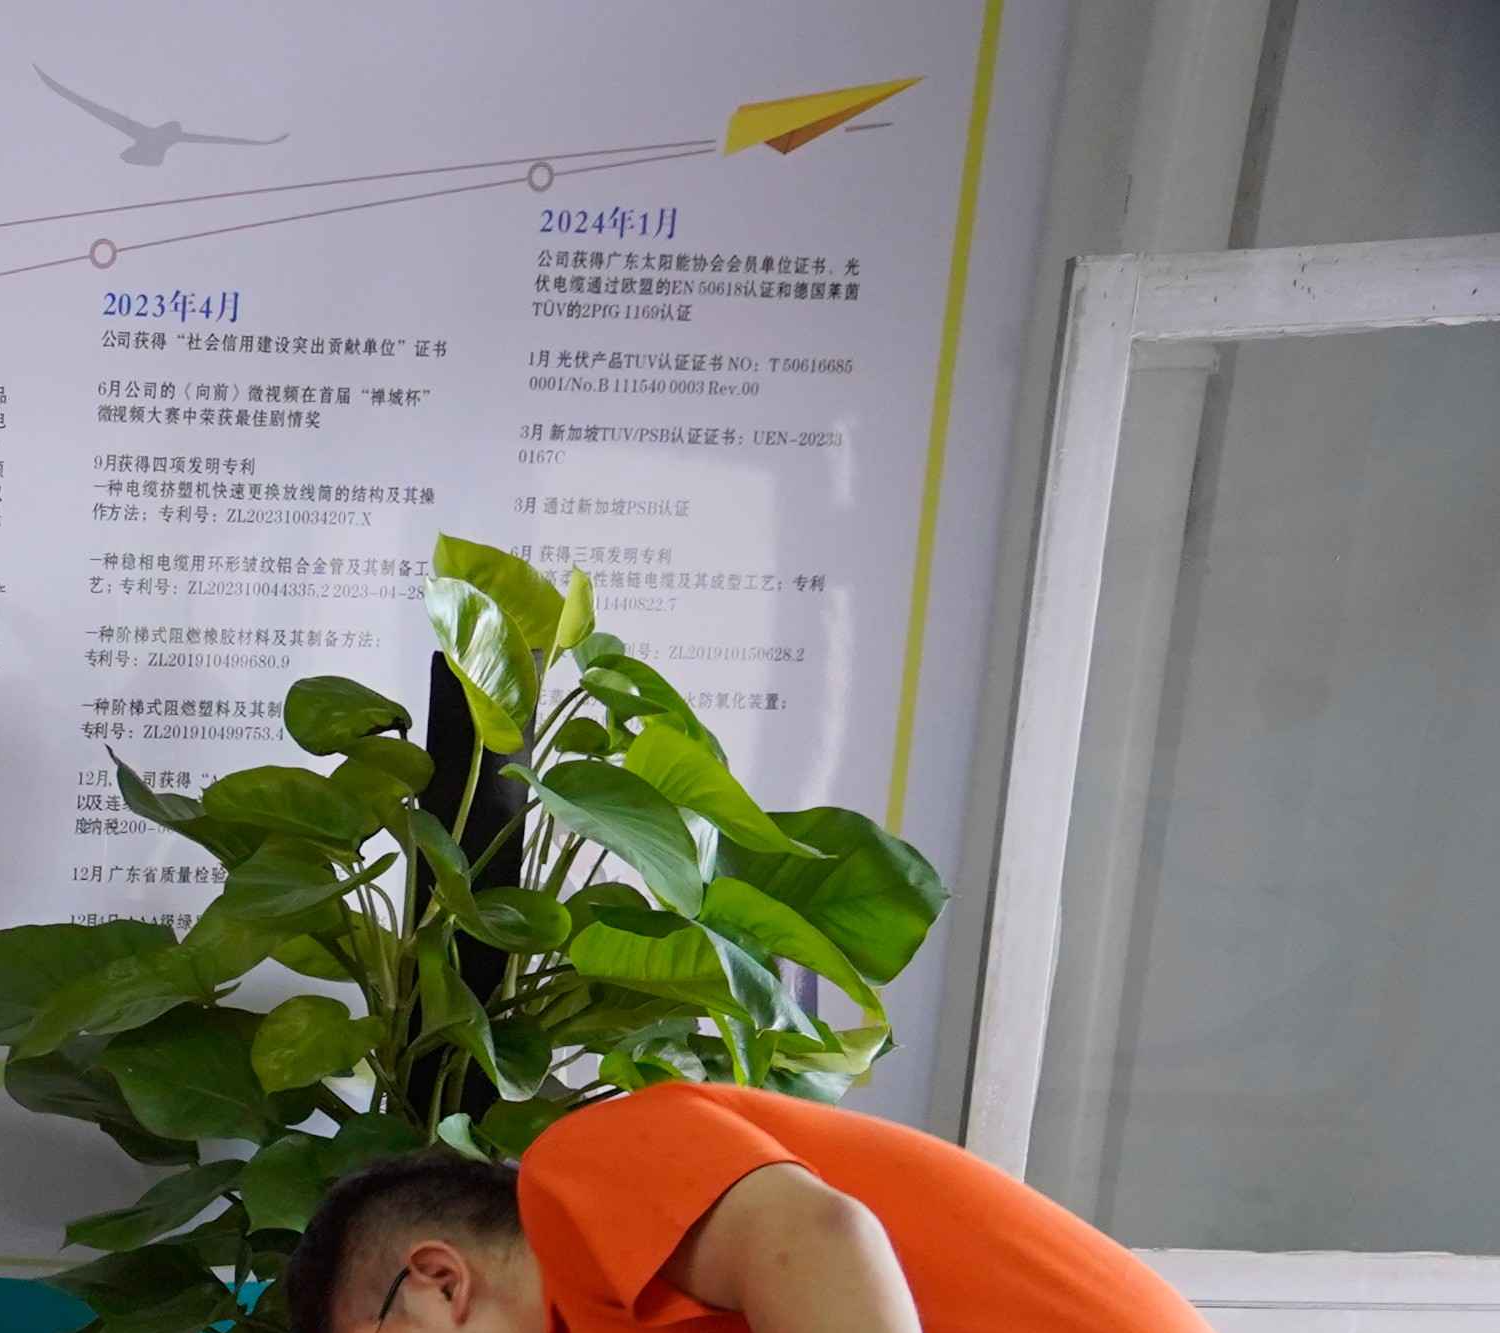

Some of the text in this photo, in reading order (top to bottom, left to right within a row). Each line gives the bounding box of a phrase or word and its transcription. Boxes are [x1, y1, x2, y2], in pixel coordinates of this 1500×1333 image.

[539, 205, 678, 239] 2024年1月
[102, 289, 241, 323] 2023年4月
[97, 404, 321, 429] 微视频大赛中荣获最佳剧情奖
[93, 453, 256, 476] 9月获得四项发明专利
